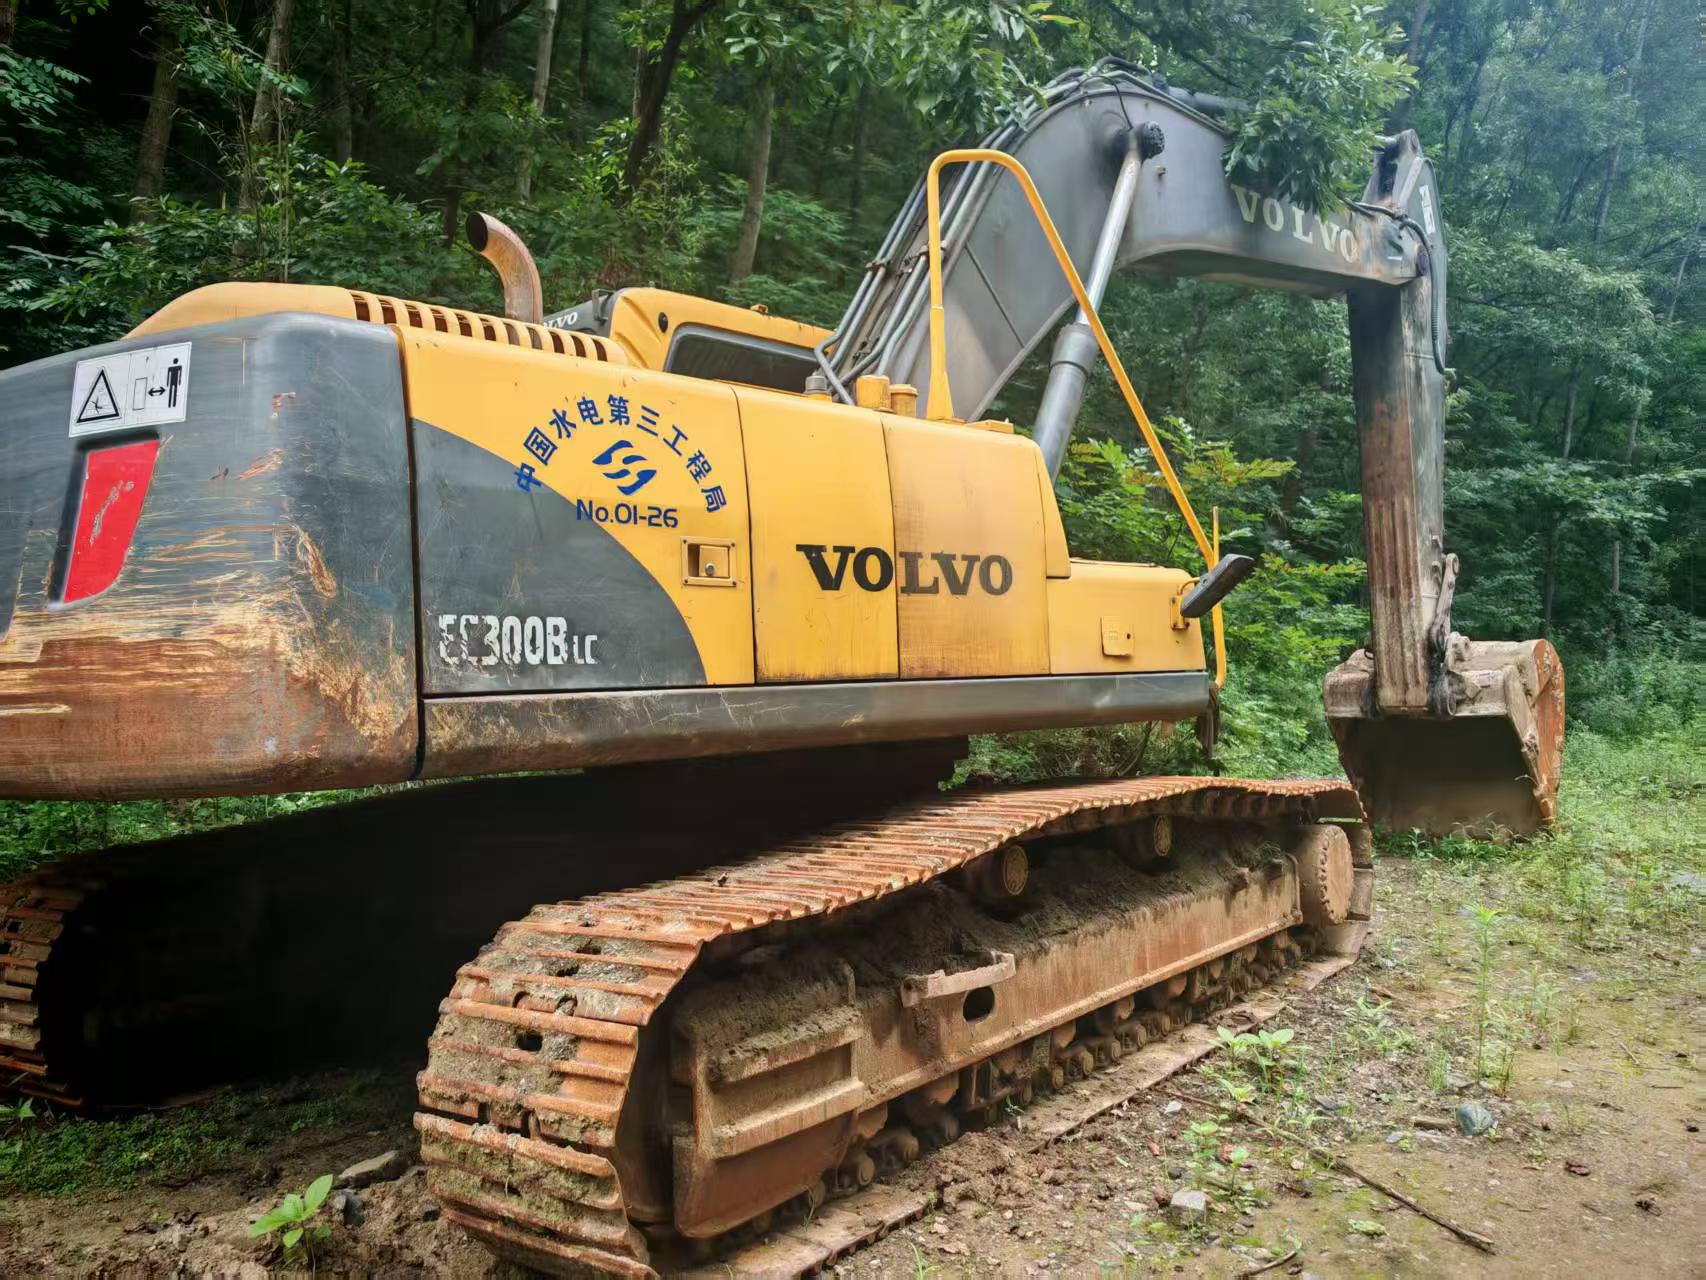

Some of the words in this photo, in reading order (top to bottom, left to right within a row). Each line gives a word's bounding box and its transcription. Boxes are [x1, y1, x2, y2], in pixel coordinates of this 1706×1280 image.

[1231, 183, 1358, 263] VOLVO
[513, 394, 727, 513] 中国水电第三工程局
[796, 544, 1013, 596] VOLVO
